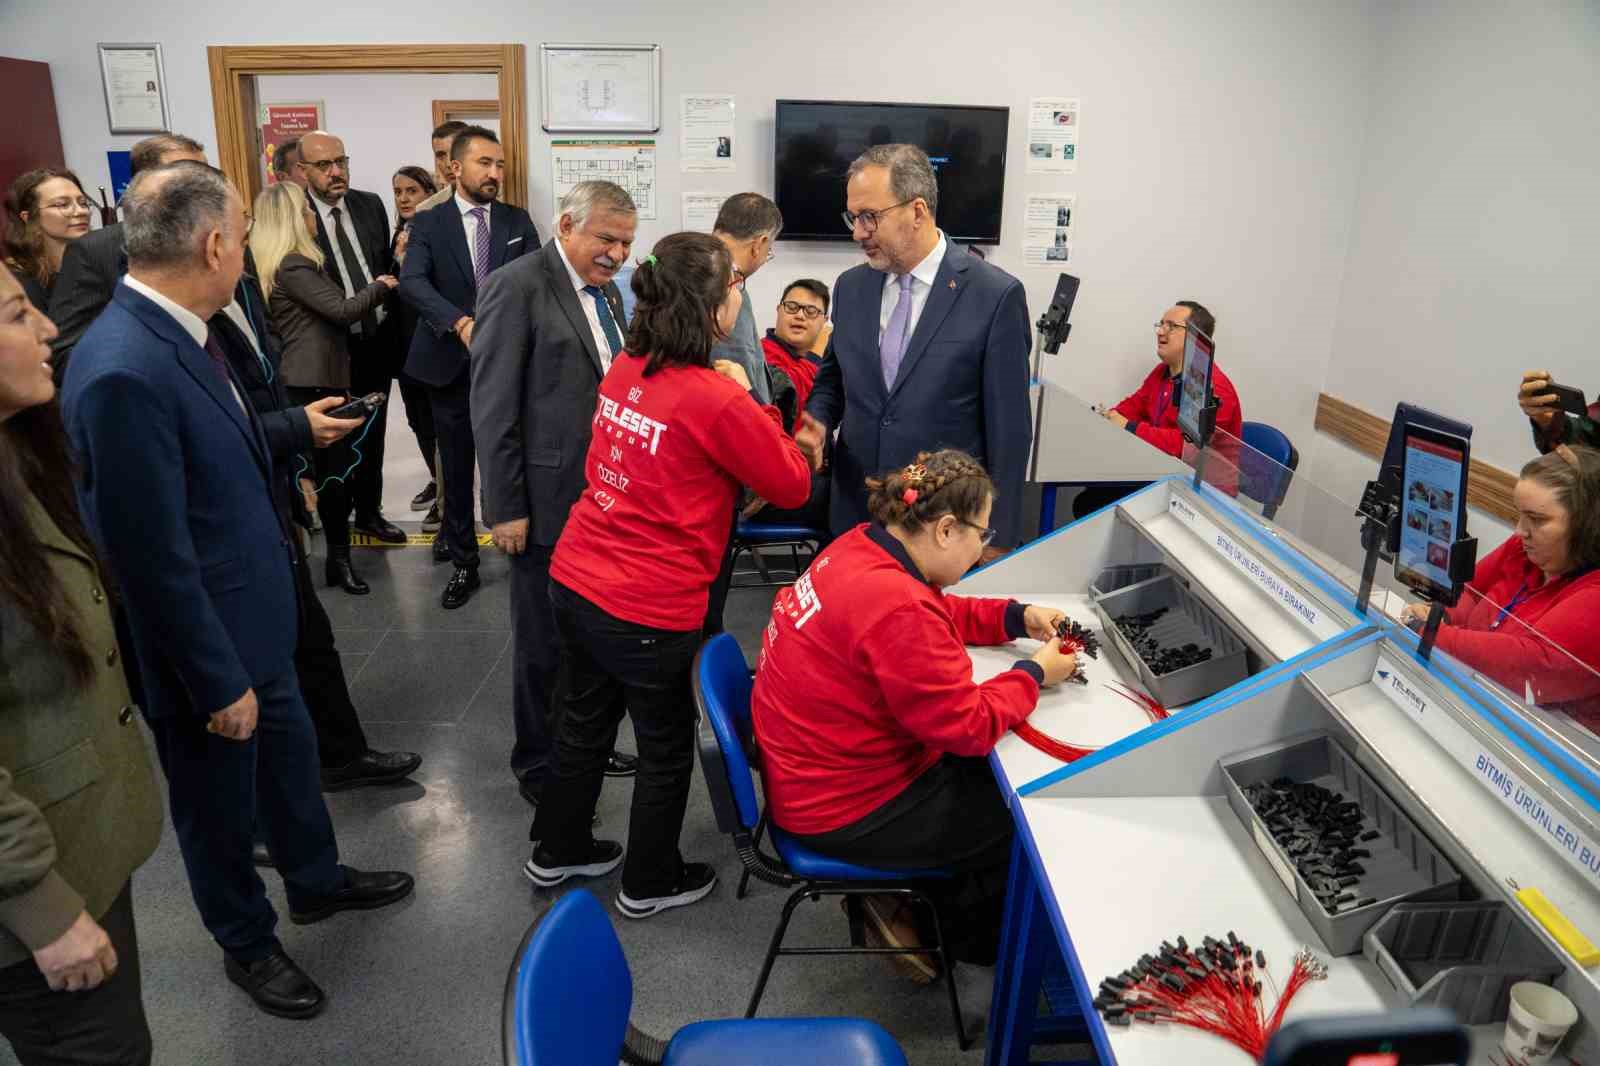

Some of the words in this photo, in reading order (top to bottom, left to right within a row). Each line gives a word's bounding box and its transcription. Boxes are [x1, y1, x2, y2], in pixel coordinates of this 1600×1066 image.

[594, 393, 668, 456] TELESET
[1476, 755, 1513, 798] BİTMİŞ
[1514, 784, 1580, 854] ÜRÜNLERİ
[1579, 847, 1600, 875] BU
